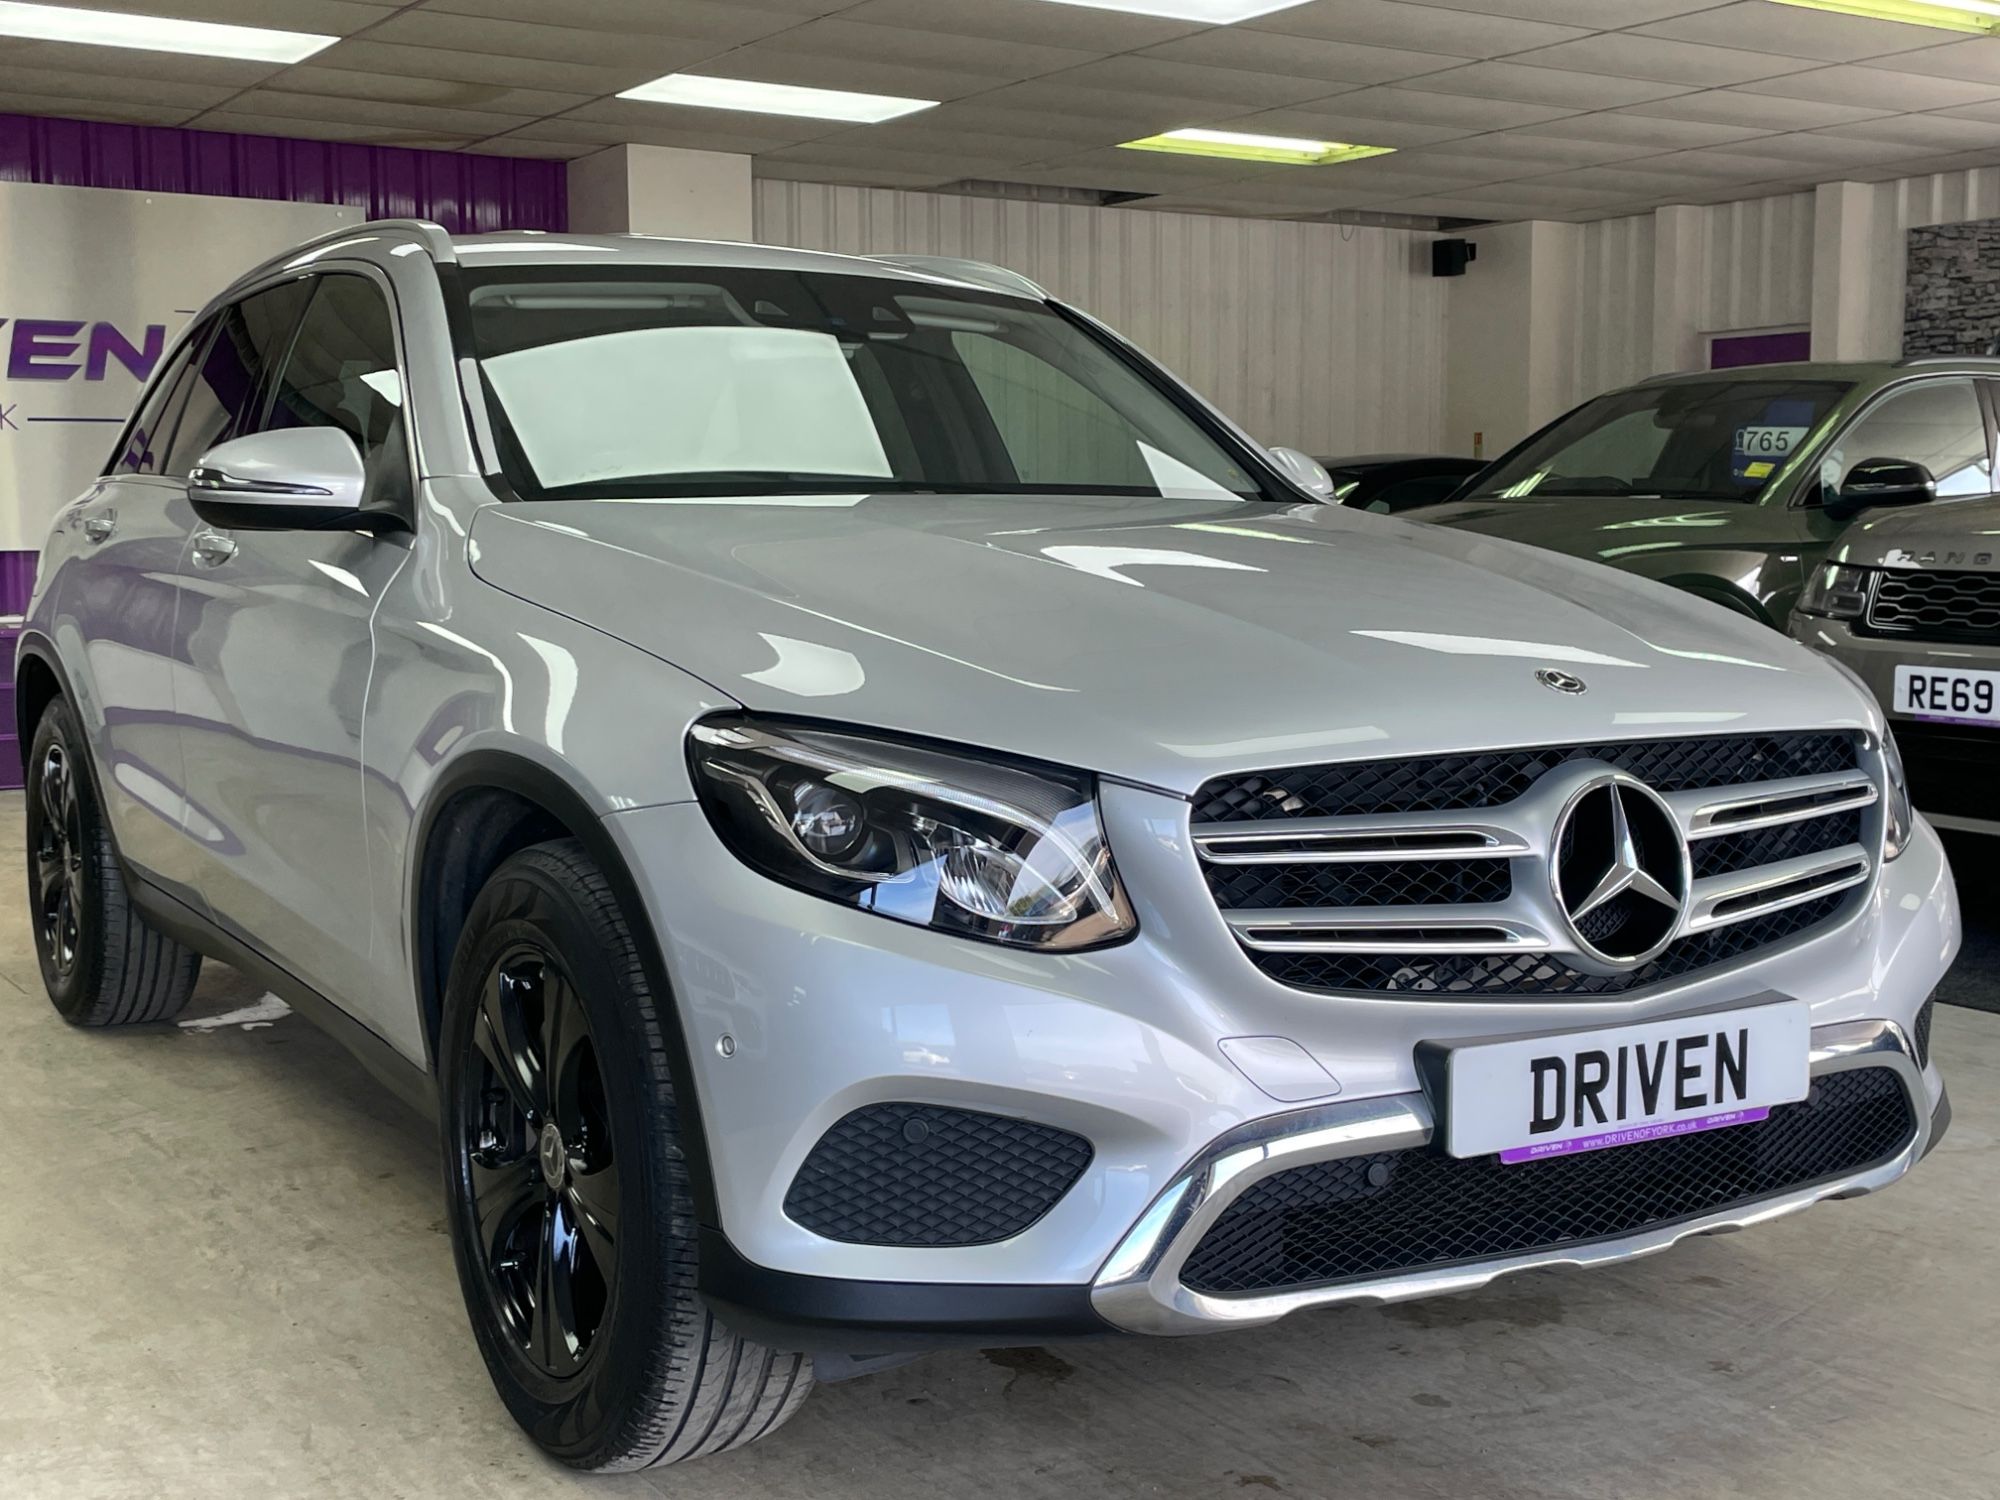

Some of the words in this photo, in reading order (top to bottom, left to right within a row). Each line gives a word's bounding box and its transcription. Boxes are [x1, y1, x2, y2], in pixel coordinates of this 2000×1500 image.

[0, 318, 166, 383] EN
[1908, 674, 1994, 714] RE69
[1529, 1028, 1749, 1135] DRIVEN
[1530, 1142, 1563, 1155] DRIVEN
[1582, 1121, 1698, 1149] www.DRIVENOFYORK.co.uk
[1706, 1113, 1736, 1125] DRIVEN
